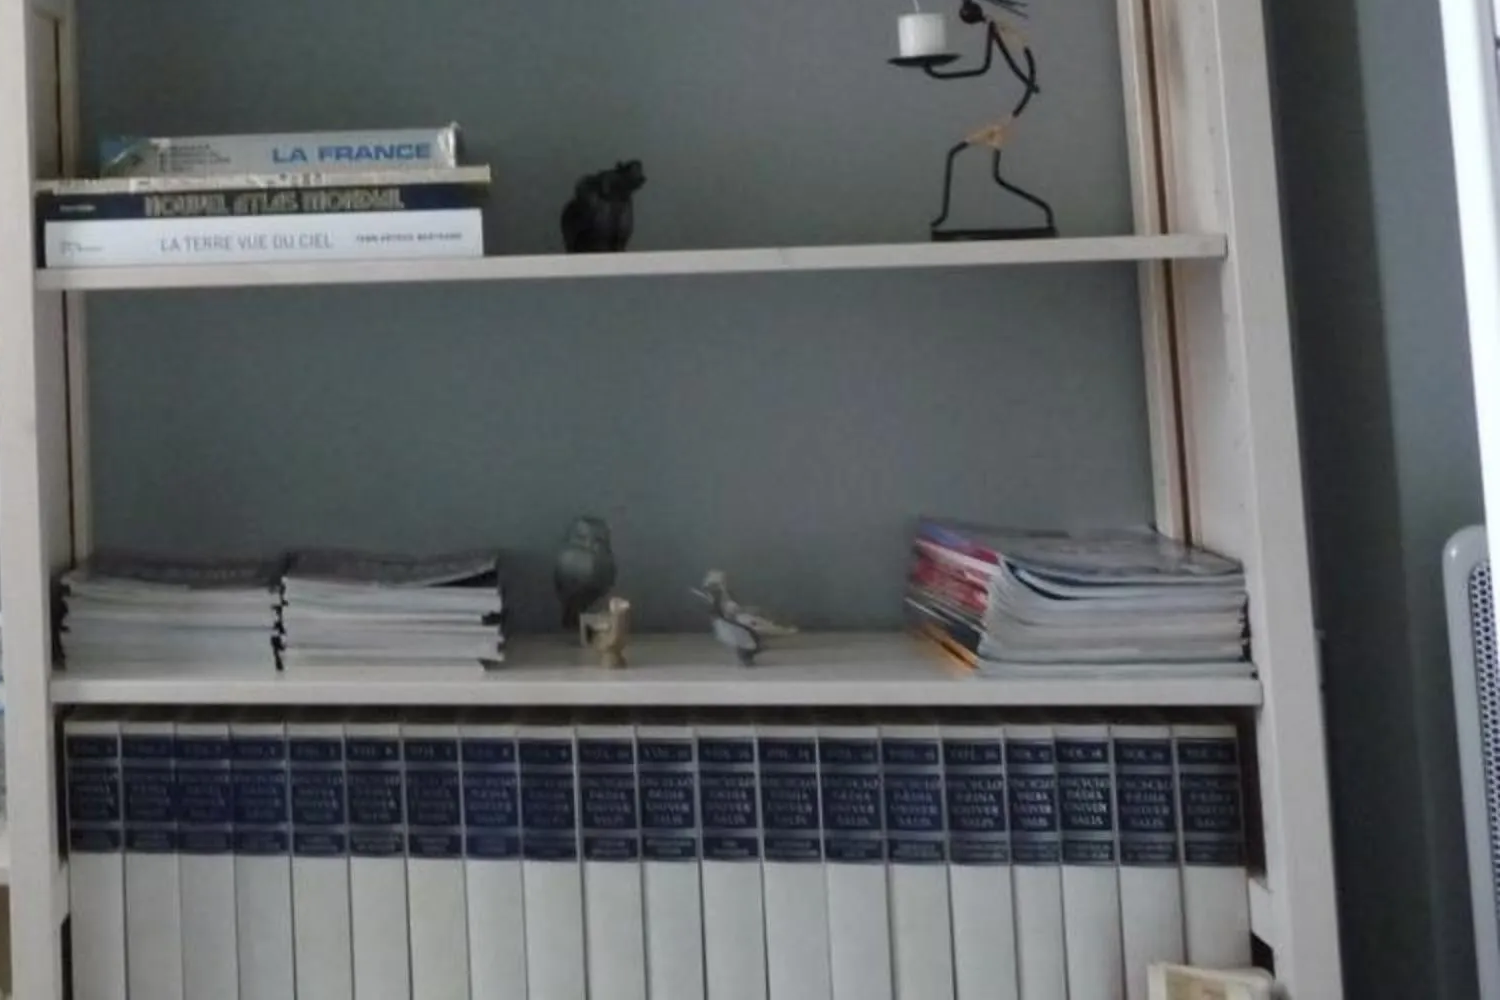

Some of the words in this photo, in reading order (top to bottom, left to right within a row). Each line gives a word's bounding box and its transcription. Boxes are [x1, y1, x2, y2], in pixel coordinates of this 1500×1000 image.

[271, 147, 308, 163] LA
[318, 143, 431, 162] FRANCE
[160, 235, 182, 252] LA
[184, 234, 230, 252] TERRE
[238, 233, 268, 250] VUE
[273, 232, 295, 249] DU
[299, 231, 334, 248] CIEL
